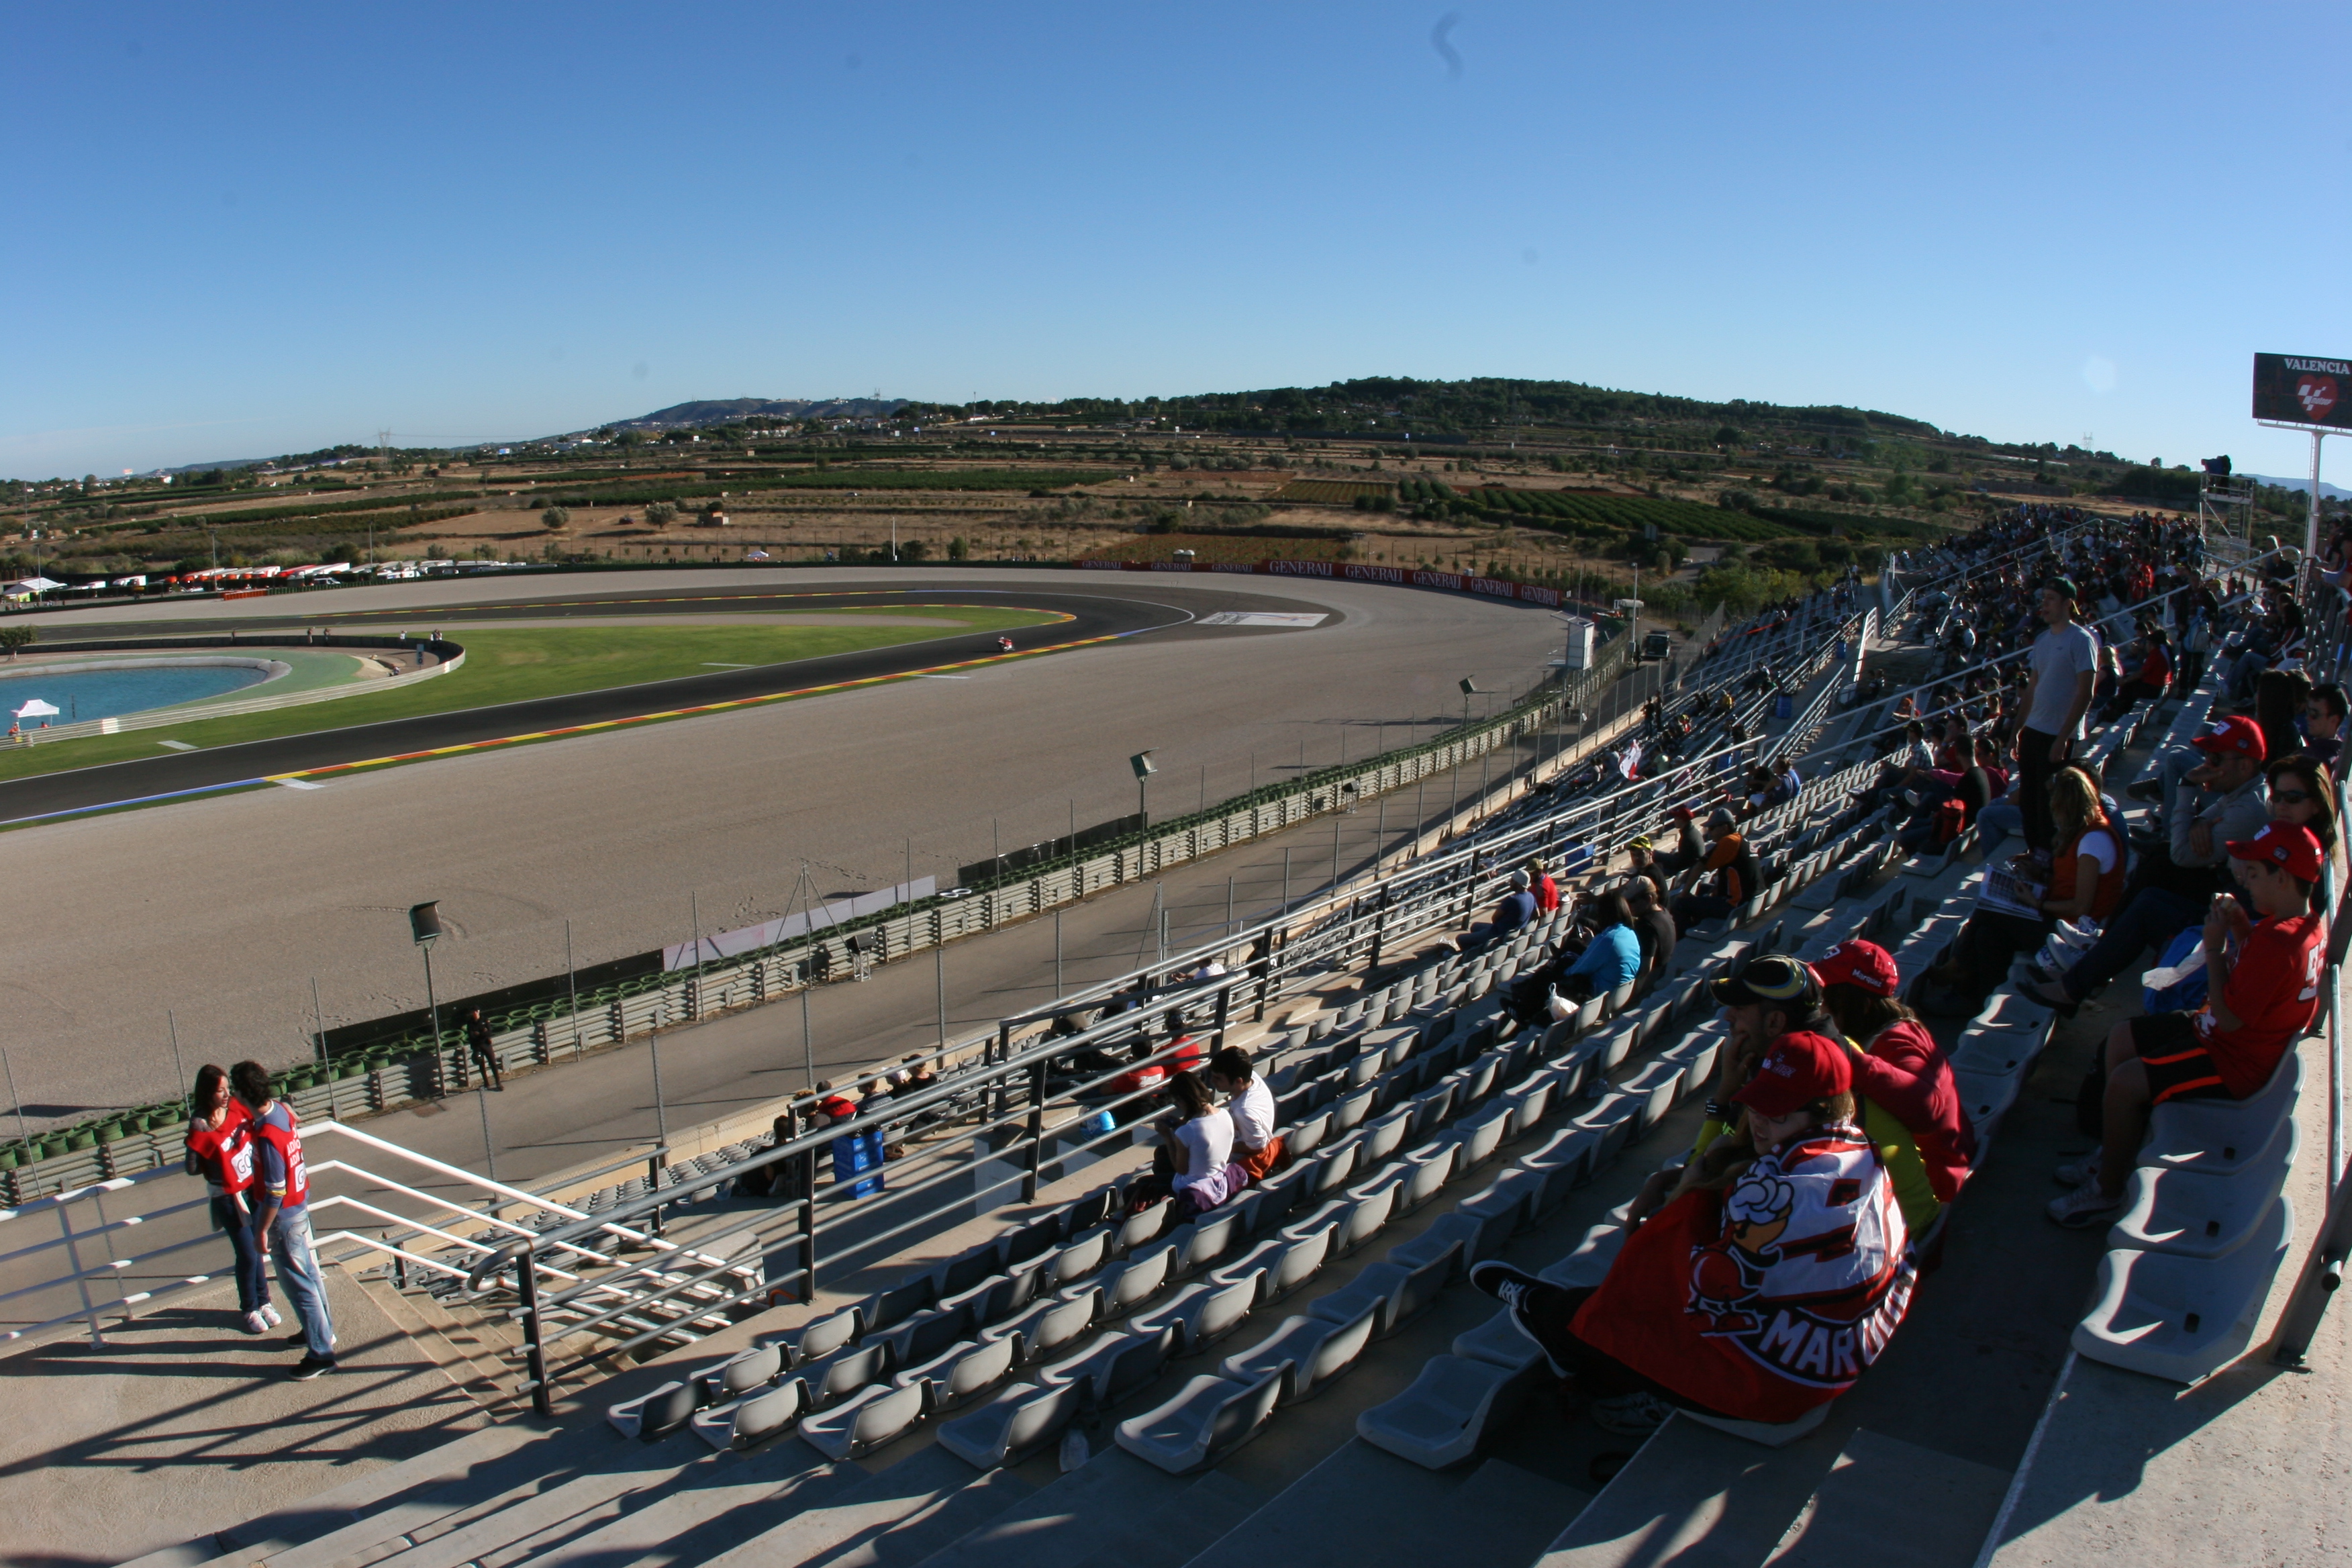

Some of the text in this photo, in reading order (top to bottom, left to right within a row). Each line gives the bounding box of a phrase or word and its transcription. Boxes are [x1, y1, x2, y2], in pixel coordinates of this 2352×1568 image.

[2284, 358, 2350, 375] VALENCIA
[1082, 560, 1121, 569] GENERALI
[1151, 562, 1191, 571] GENERALI
[1212, 564, 1253, 572] GENERALI
[1269, 560, 1332, 576] GENERALI
[1346, 565, 1403, 582] GENERALI
[1414, 571, 1461, 589] GENERALI
[1471, 577, 1513, 597] GENERALI
[1522, 585, 1558, 606] GENERALI
[1853, 969, 1882, 987] Marquez
